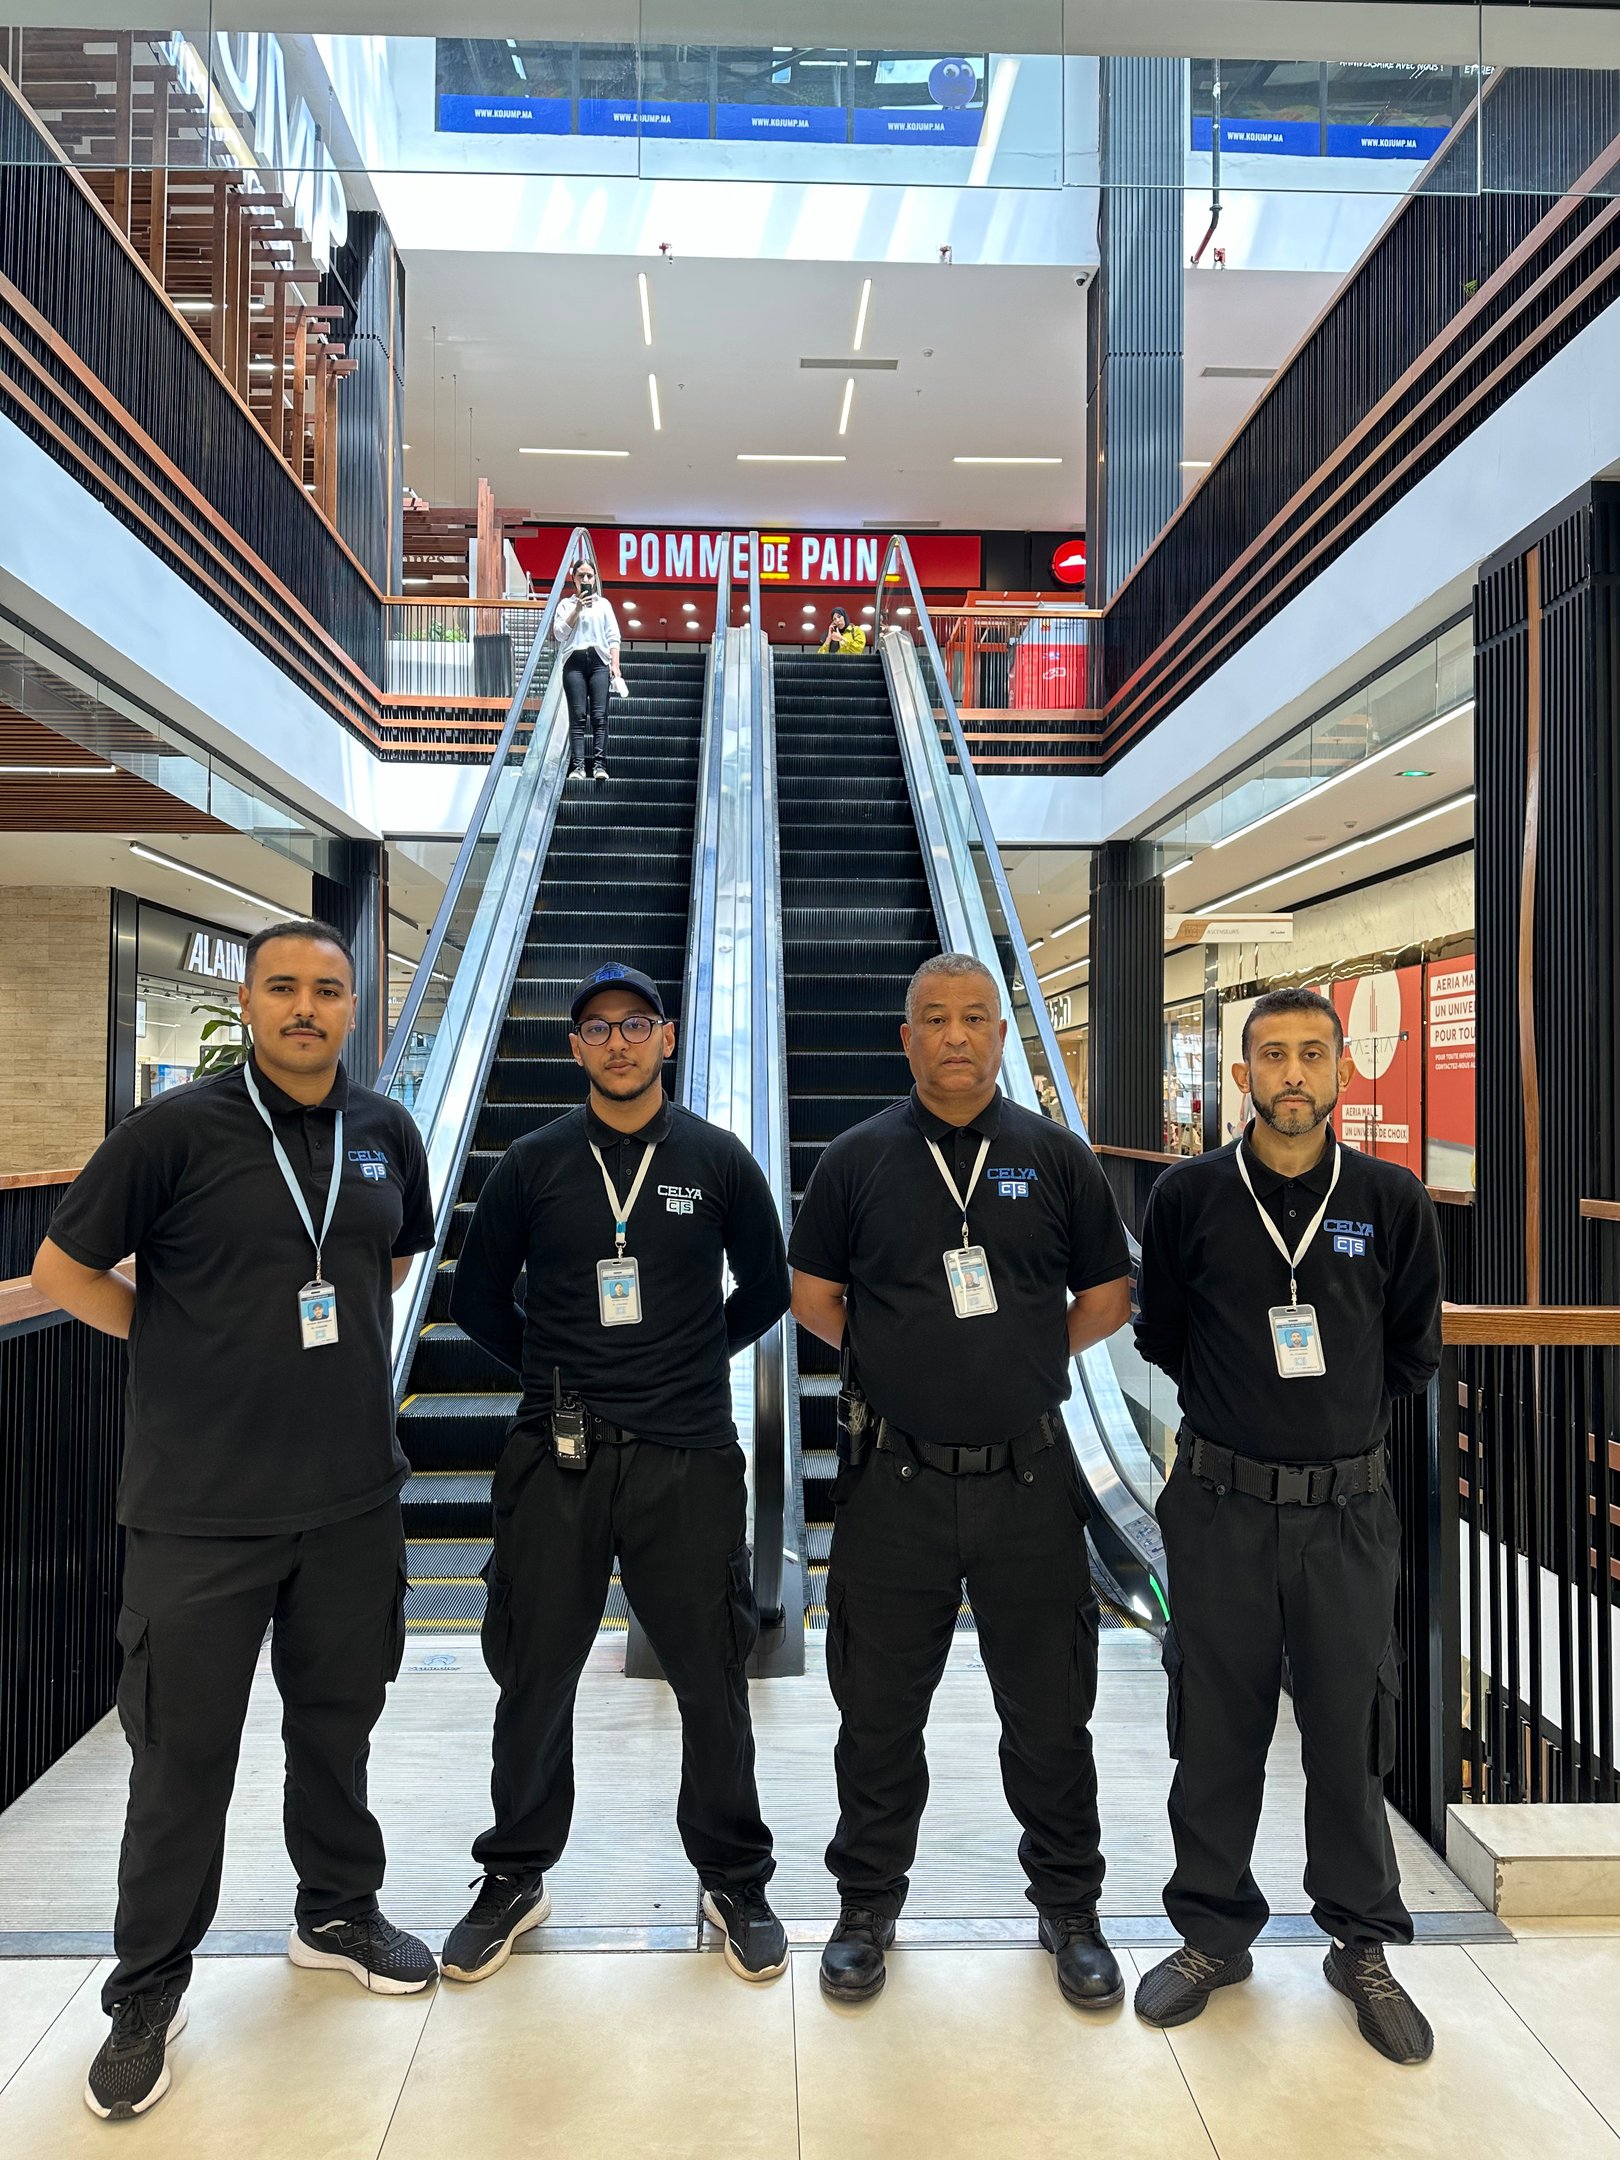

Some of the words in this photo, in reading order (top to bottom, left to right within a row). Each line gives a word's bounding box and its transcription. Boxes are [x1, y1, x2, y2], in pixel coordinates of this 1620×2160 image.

[474, 109, 533, 119] WWW.KOJUMP.MA
[613, 113, 671, 123] WWW.KOJUMP.MA
[751, 117, 809, 128] WWW.KOJUMP.MA
[888, 122, 945, 132] WWW.KOJUMP.MA
[1227, 131, 1284, 143] WWW.KOJUMP.MA
[1361, 138, 1417, 148] WWW.KOJUMP.MA
[619, 532, 749, 578] POMME
[763, 543, 788, 572] DE
[802, 536, 877, 581] PAIN
[188, 932, 246, 984] ALAIN
[1436, 976, 1460, 991] AERIA
[1435, 1004, 1446, 1017] UN
[1448, 1001, 1475, 1015] UNIVE
[1435, 1028, 1457, 1042] POUR
[1378, 1129, 1387, 1138] DE
[348, 1150, 389, 1164] CELYA
[987, 1168, 1038, 1181] CELYA
[657, 1185, 703, 1200] CELYA
[1323, 1219, 1374, 1237] CELYA
